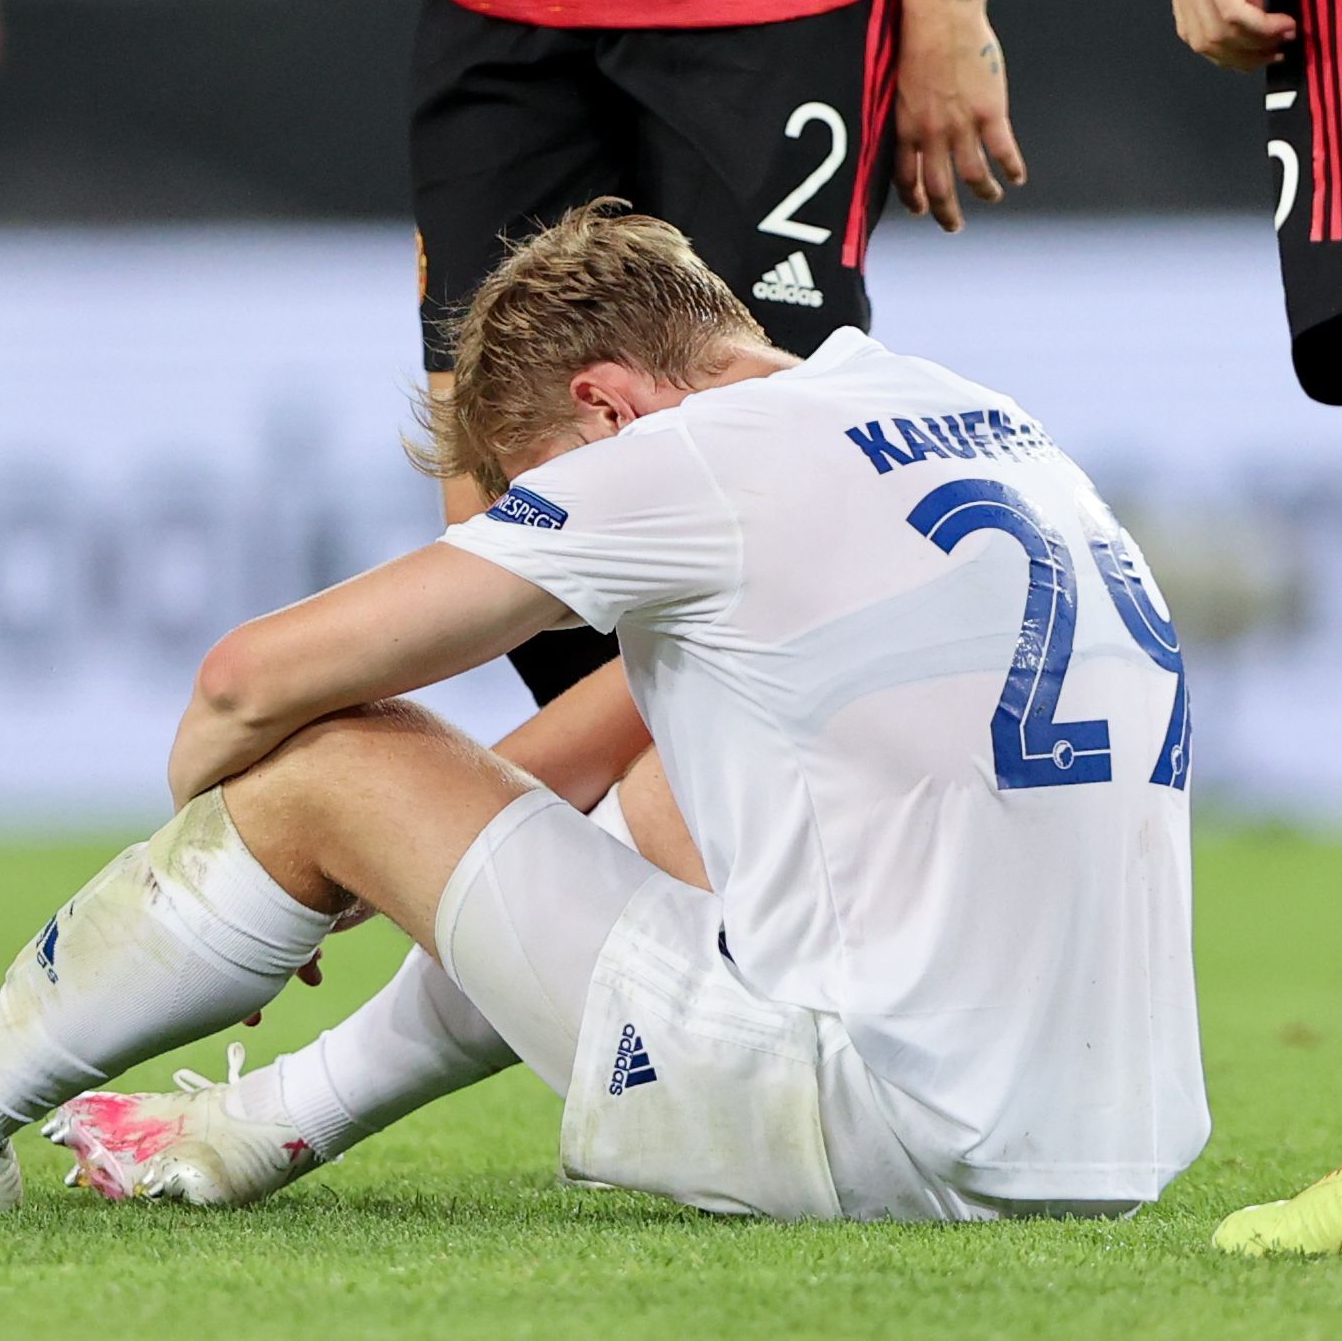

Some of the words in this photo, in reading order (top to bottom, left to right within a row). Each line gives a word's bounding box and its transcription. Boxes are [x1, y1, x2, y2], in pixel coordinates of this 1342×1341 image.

[757, 101, 849, 245] 2
[752, 281, 824, 309] adidas
[906, 478, 1193, 791] 29
[608, 1022, 636, 1096] adidas
